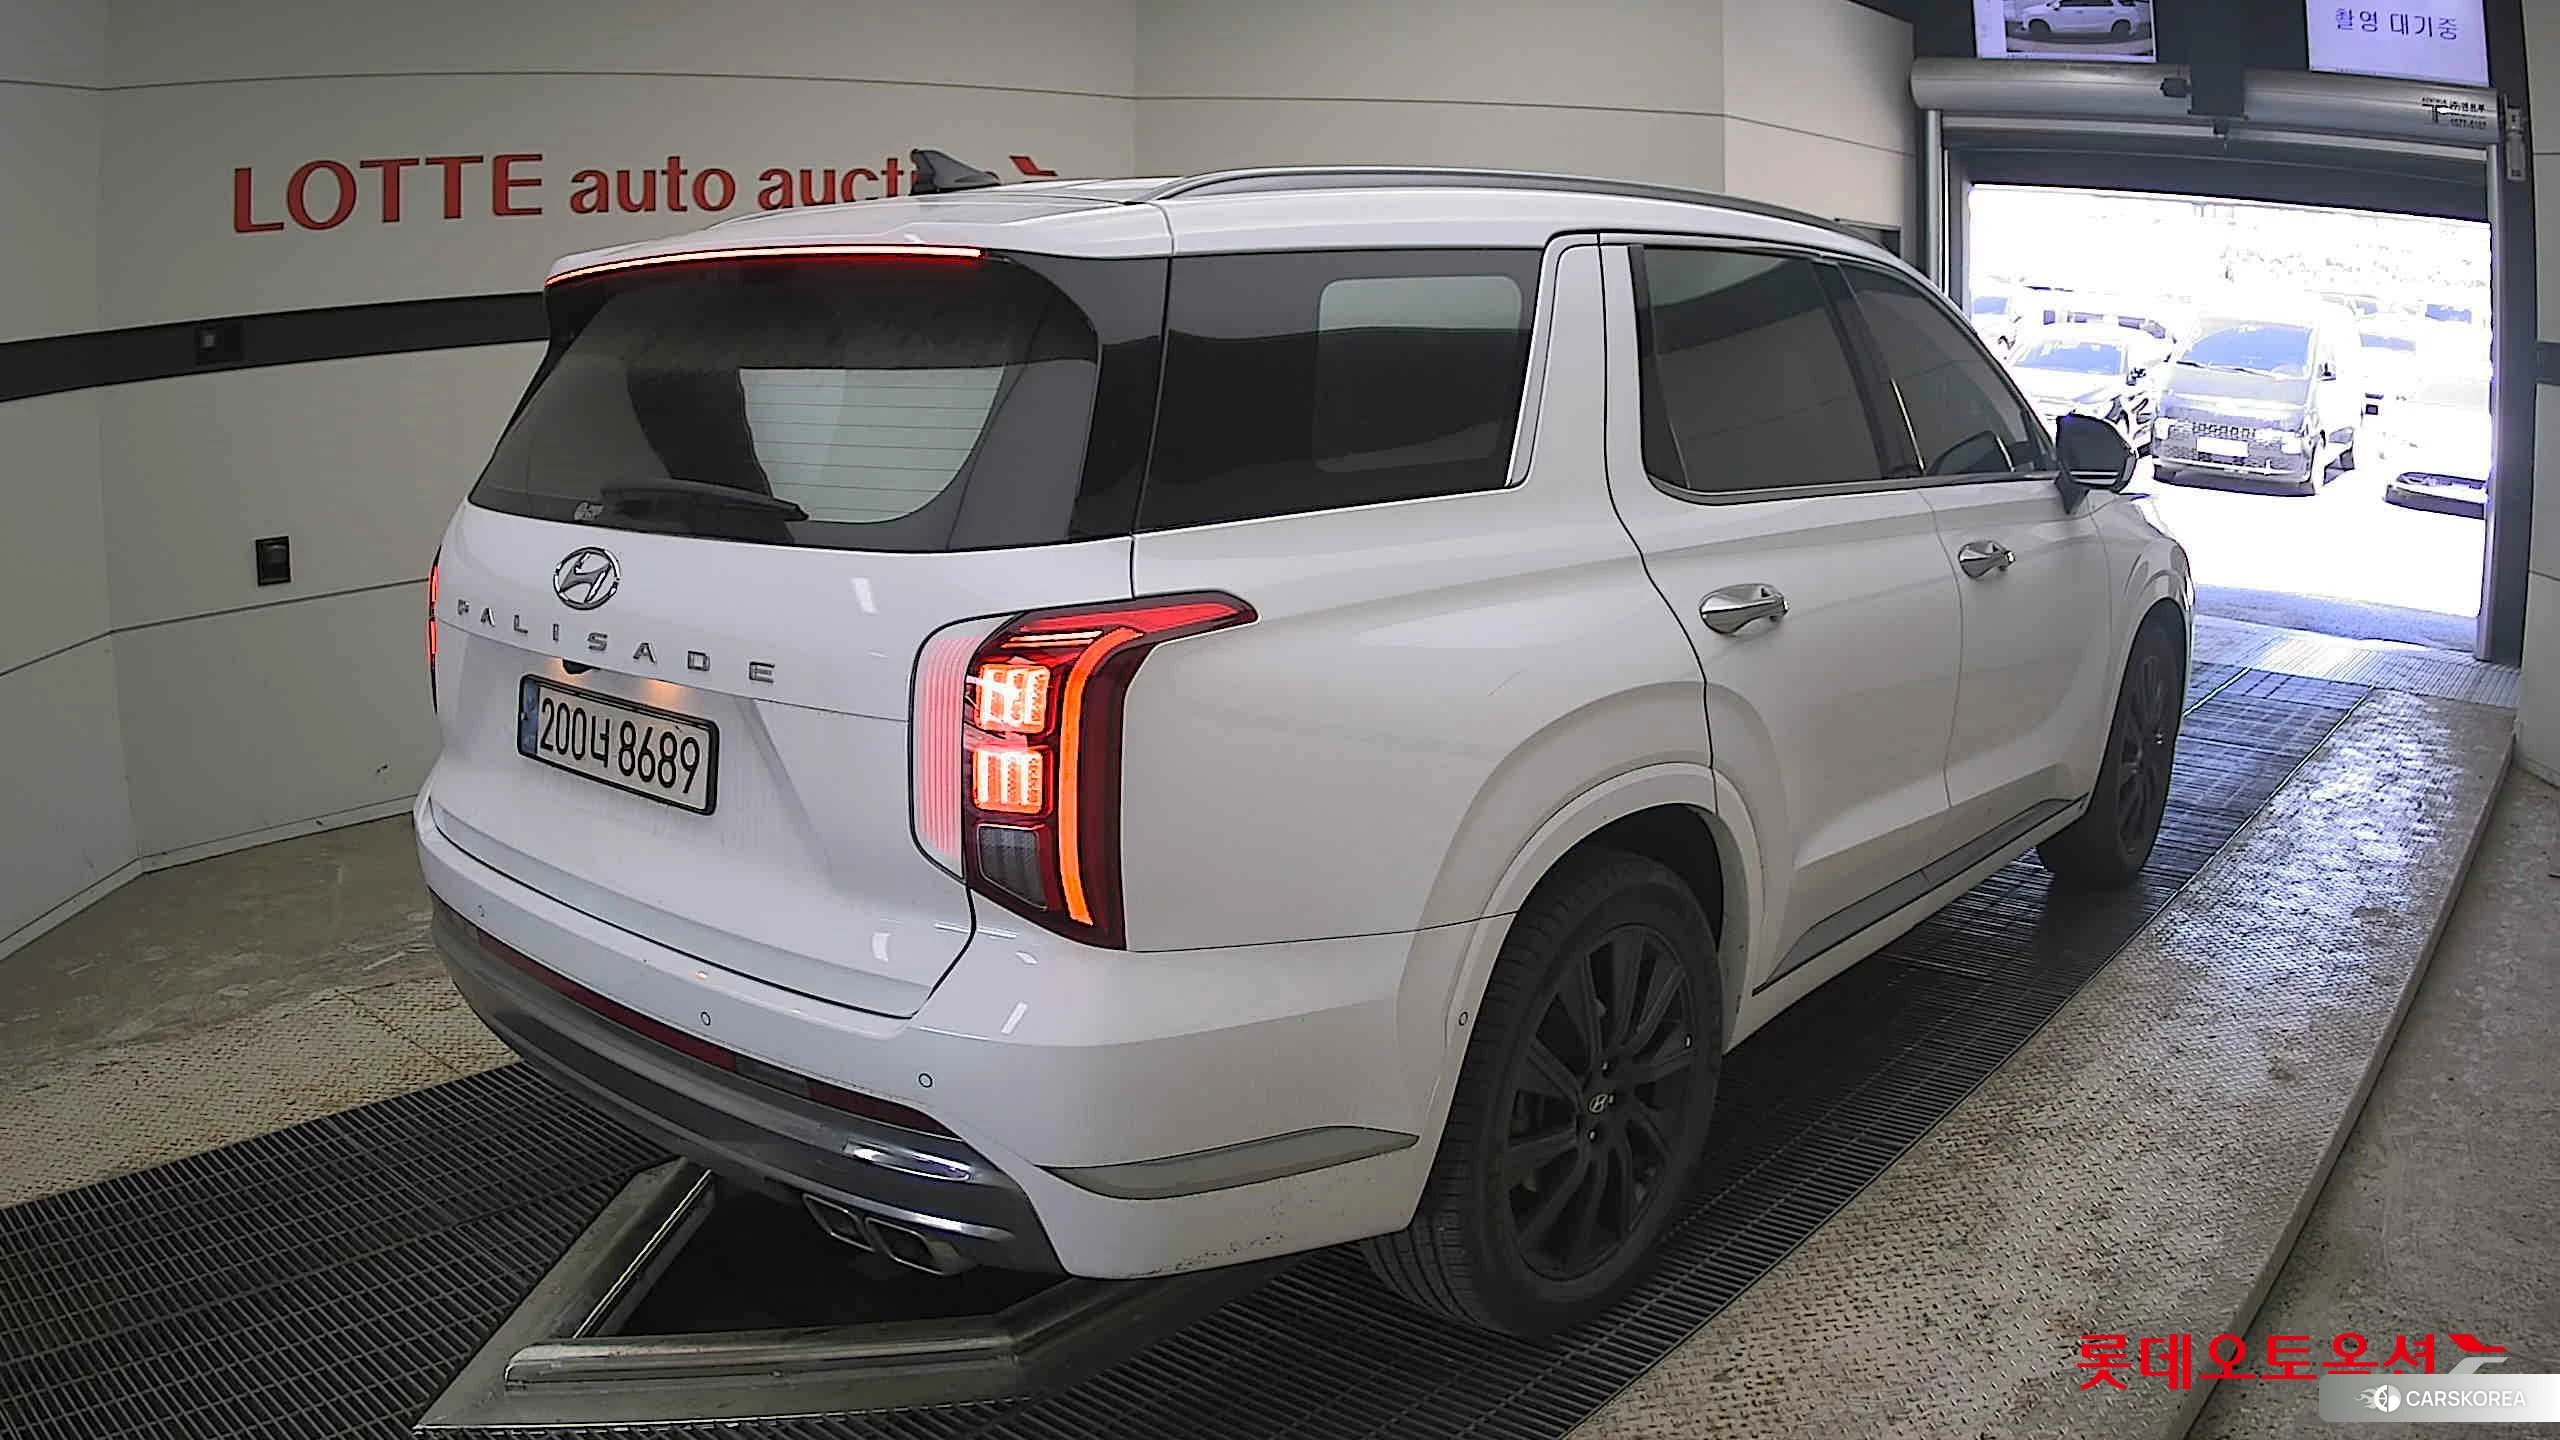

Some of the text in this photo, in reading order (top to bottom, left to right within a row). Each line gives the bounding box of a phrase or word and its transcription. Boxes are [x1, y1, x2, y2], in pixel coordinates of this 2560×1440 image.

[2335, 8, 2379, 33] 촬영
[234, 154, 1000, 233] LOTTE auto auct
[456, 598, 776, 685] PALISADE
[617, 720, 701, 794] 8689
